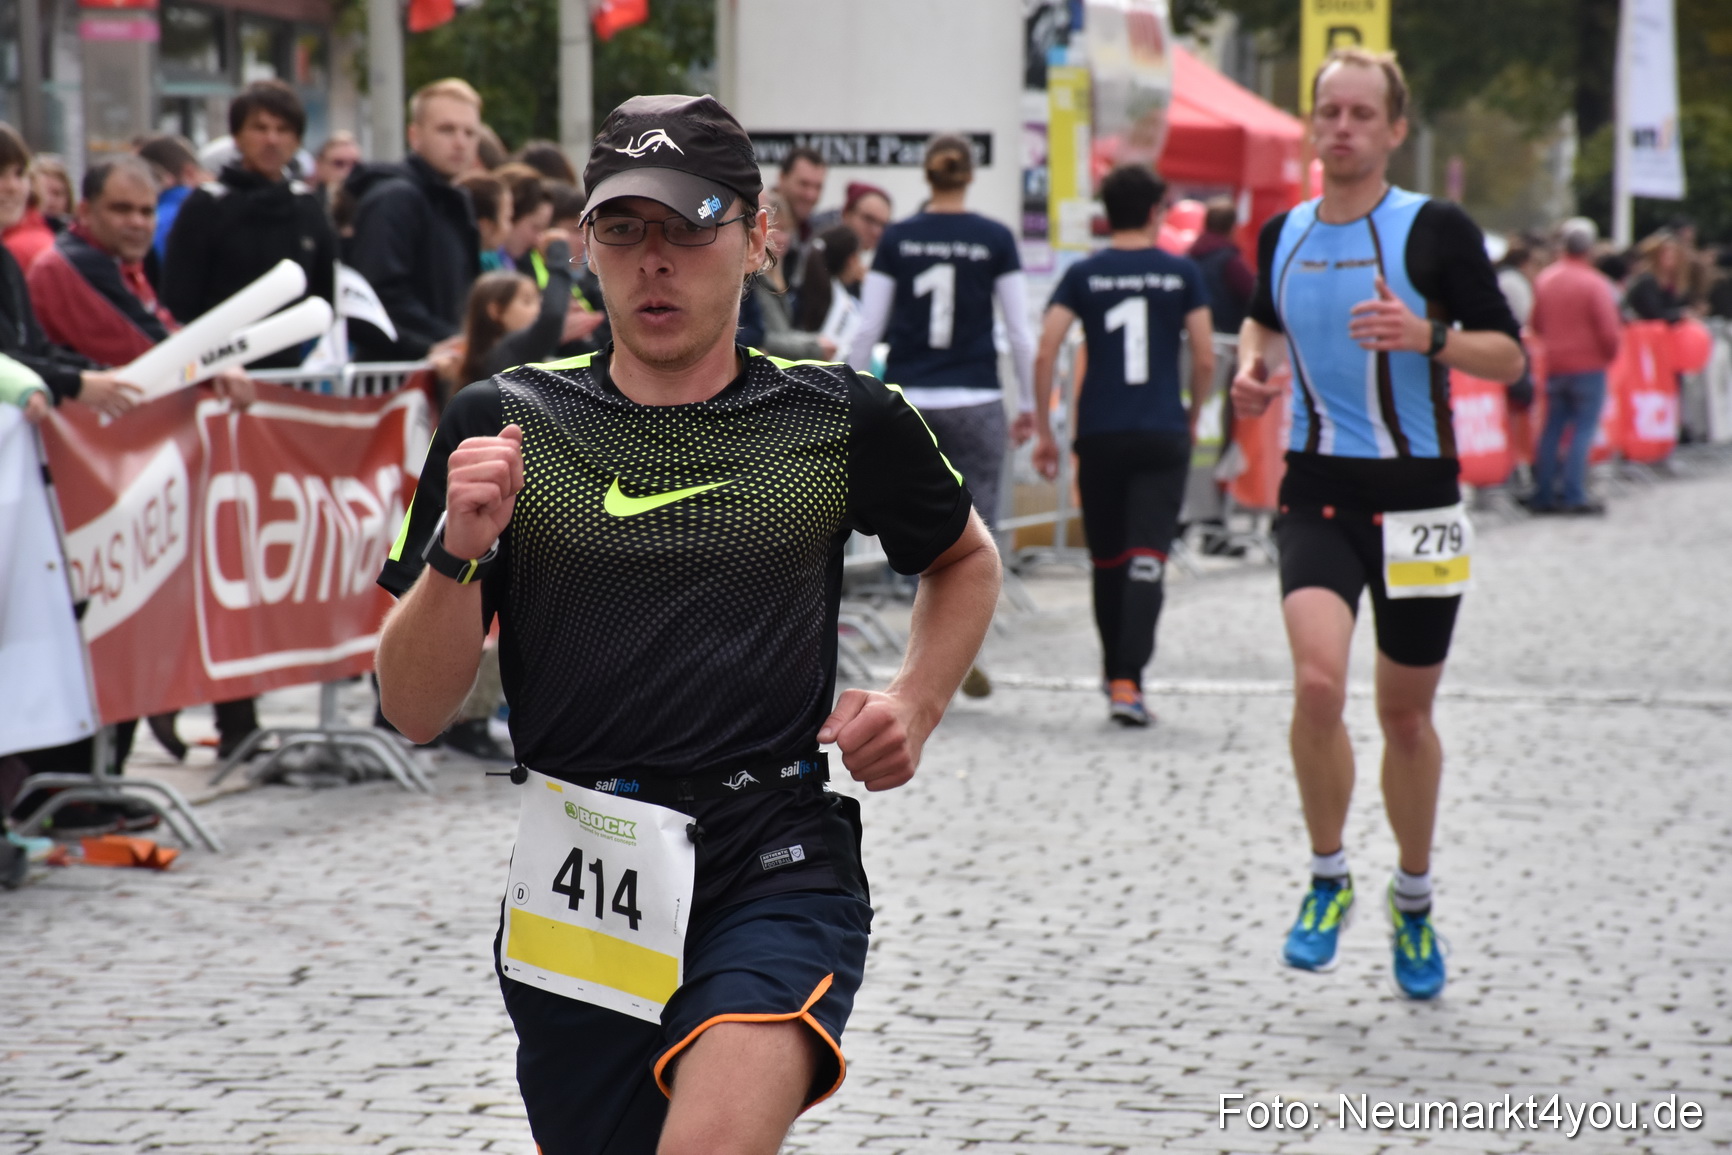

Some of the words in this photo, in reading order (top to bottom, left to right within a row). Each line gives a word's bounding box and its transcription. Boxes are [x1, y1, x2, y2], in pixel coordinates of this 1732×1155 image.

[697, 194, 722, 219] sailfish
[913, 263, 954, 349] 1
[1104, 296, 1148, 385] 1
[1411, 521, 1462, 555] 279
[595, 778, 640, 795] sailfish
[578, 806, 637, 840] BOCK
[764, 857, 792, 868] FOOTBALL
[517, 887, 524, 900] D
[552, 847, 642, 931] 414
